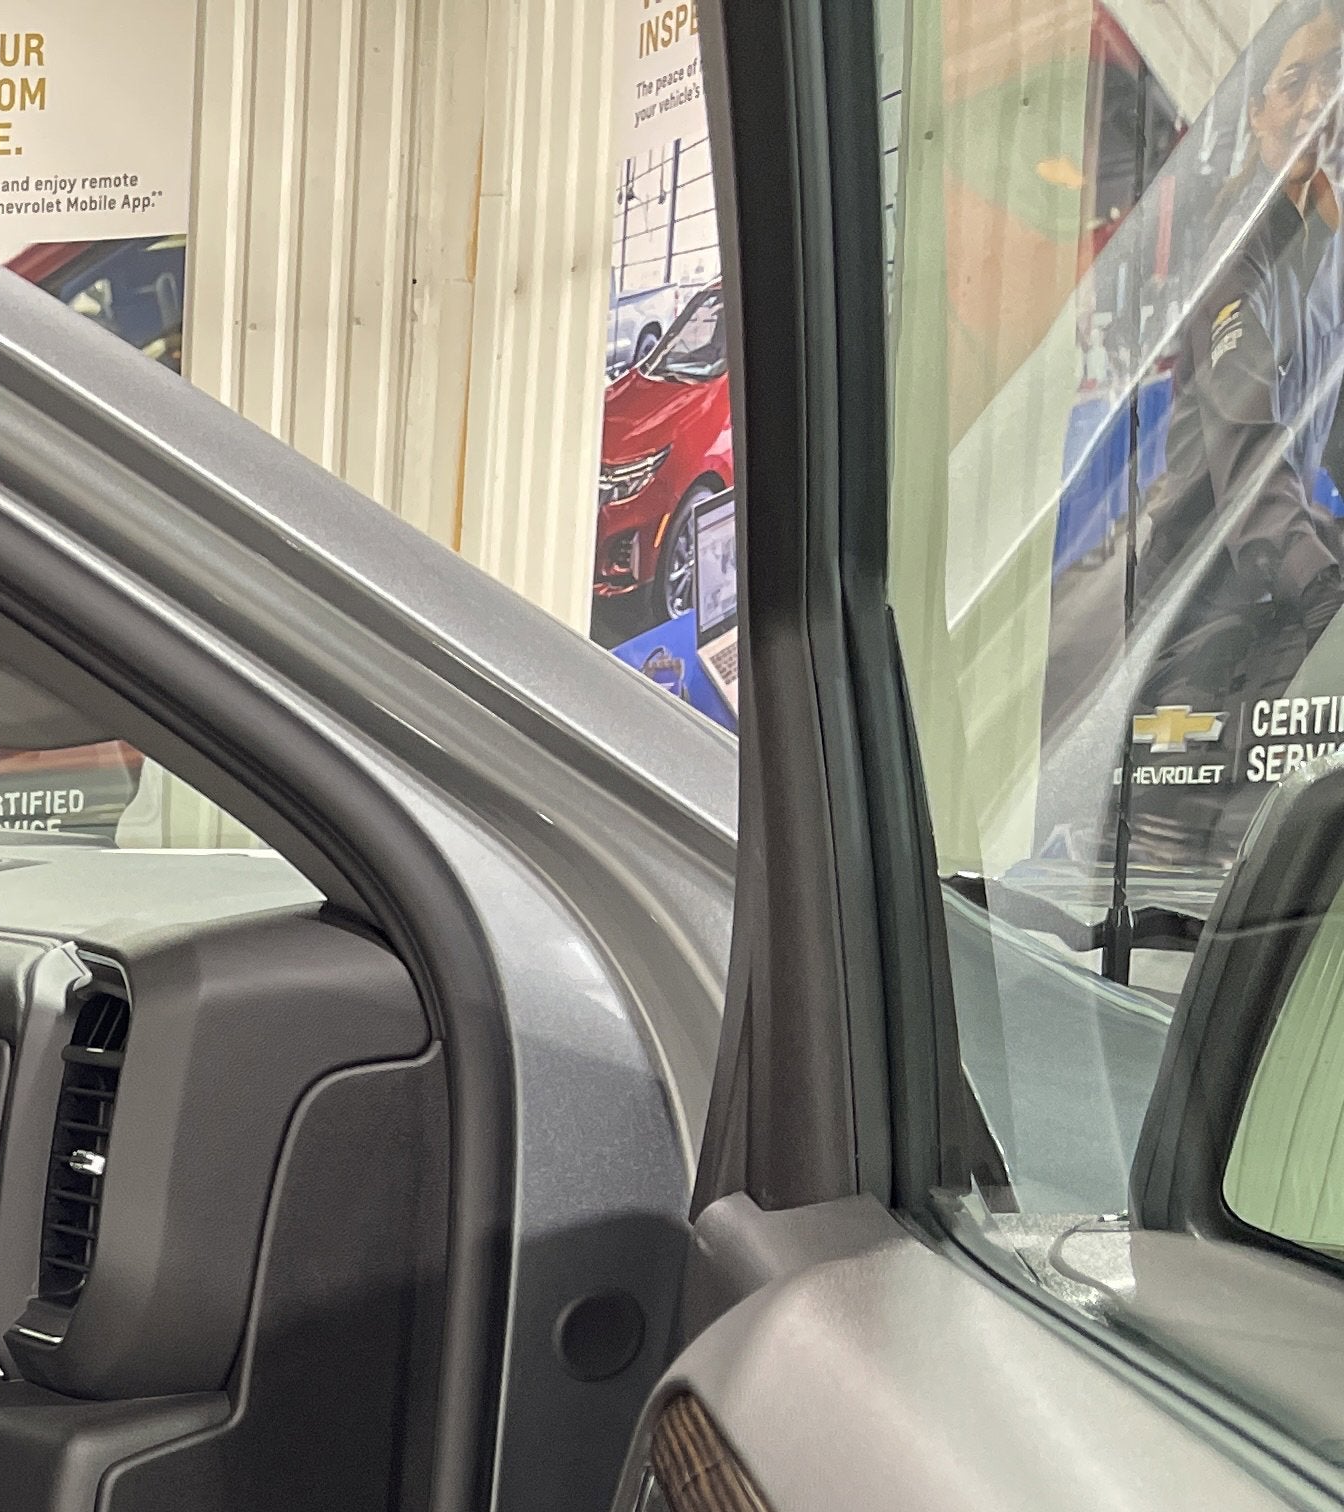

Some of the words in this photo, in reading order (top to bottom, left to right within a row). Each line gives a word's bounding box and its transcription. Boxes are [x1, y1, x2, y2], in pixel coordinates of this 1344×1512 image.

[636, 81, 653, 99] The
[655, 68, 684, 97] peace
[687, 57, 698, 78] of
[634, 104, 657, 128] your
[659, 82, 700, 113] vehicle's
[0, 175, 31, 193] and
[34, 174, 77, 195] enjoy
[80, 172, 139, 190] remote
[66, 195, 117, 213] Mobile
